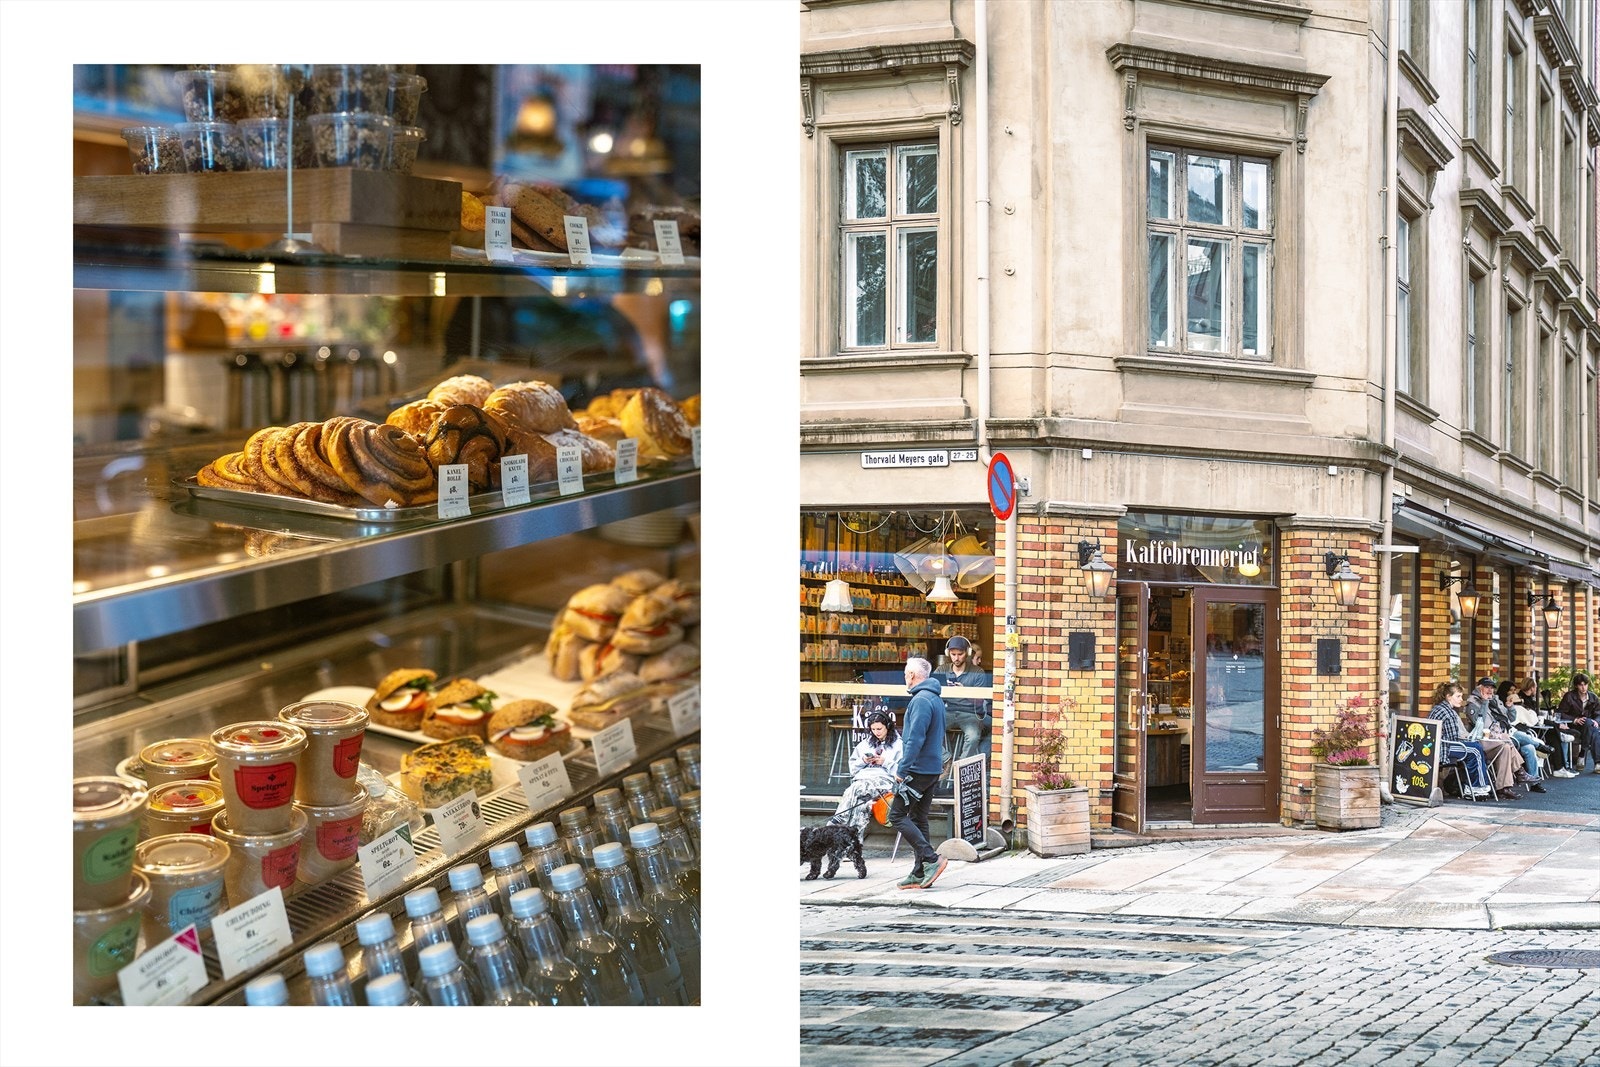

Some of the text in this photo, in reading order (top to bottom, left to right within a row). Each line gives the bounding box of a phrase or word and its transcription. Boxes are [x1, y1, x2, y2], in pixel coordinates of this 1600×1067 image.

[864, 453, 944, 466] Thorvald Meyers gate
[1125, 538, 1260, 568] Kaffebrenneriet
[1412, 775, 1428, 788] 108,-
[225, 900, 272, 928] CHIAPUDDING
